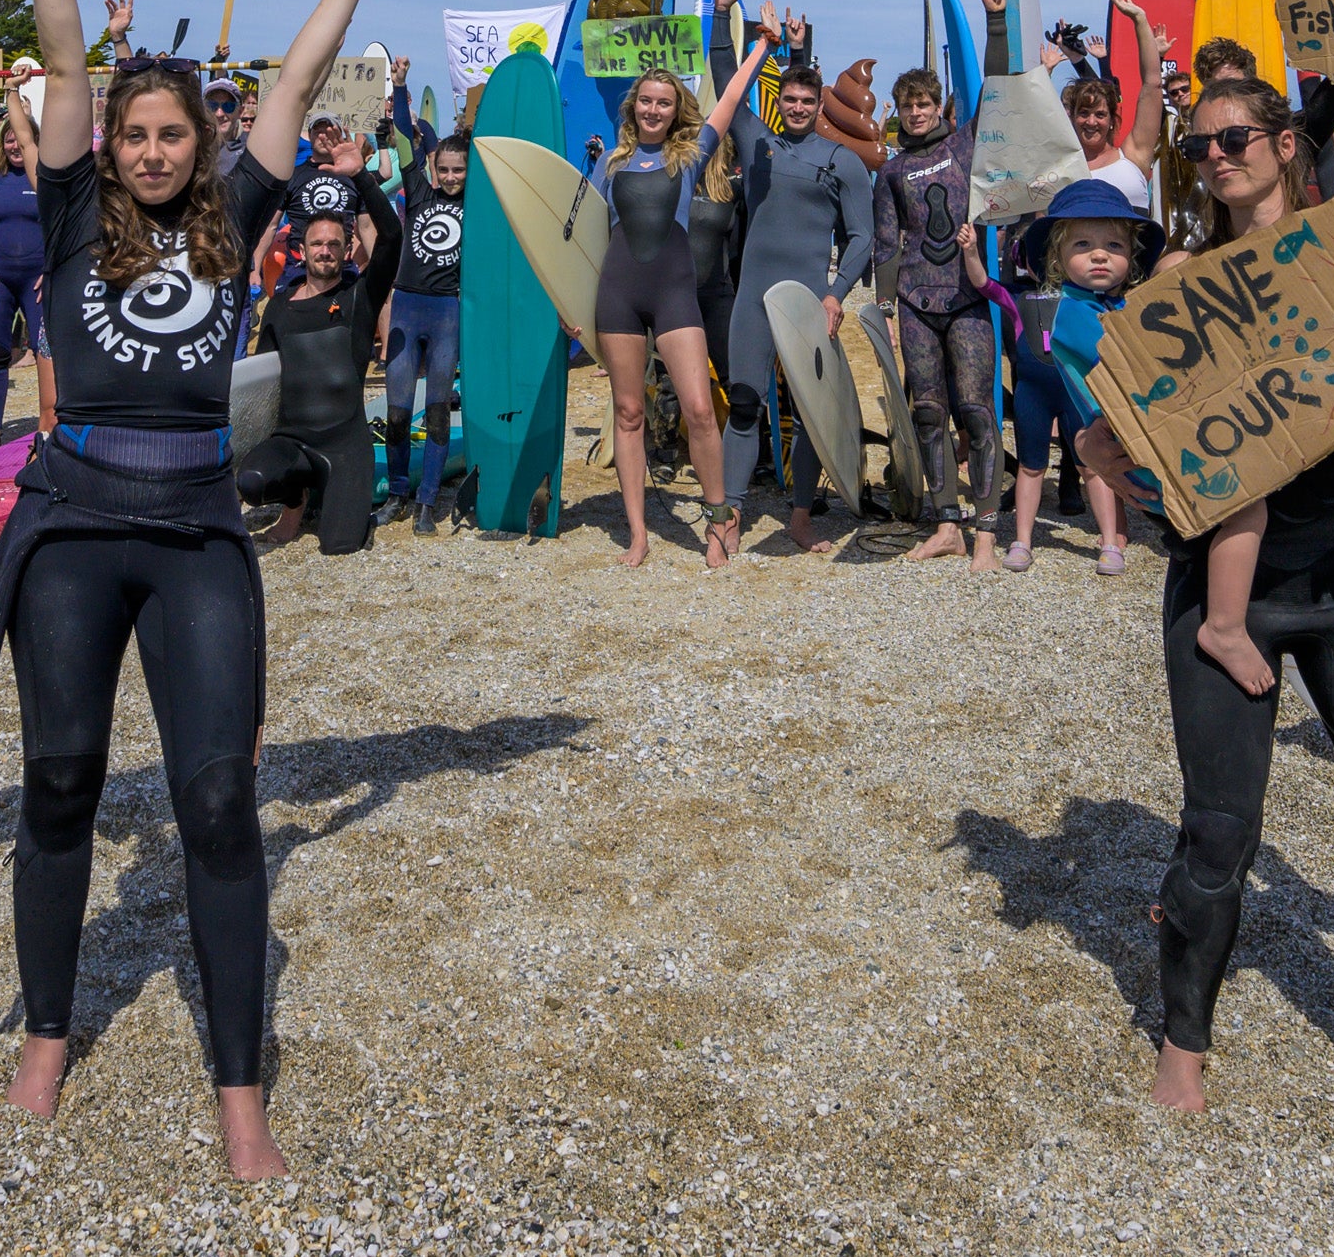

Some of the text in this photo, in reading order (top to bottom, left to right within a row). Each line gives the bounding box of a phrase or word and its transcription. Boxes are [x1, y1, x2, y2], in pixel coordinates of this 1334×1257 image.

[466, 25, 499, 43] SEA
[613, 22, 679, 46] SWW
[460, 46, 497, 64] SICK
[355, 63, 376, 81] TO
[908, 159, 951, 180] CRESSI
[412, 216, 432, 263] AGAINST
[1140, 249, 1282, 369] SAVE
[82, 271, 160, 372] GAINST
[1196, 367, 1322, 457] OUR
